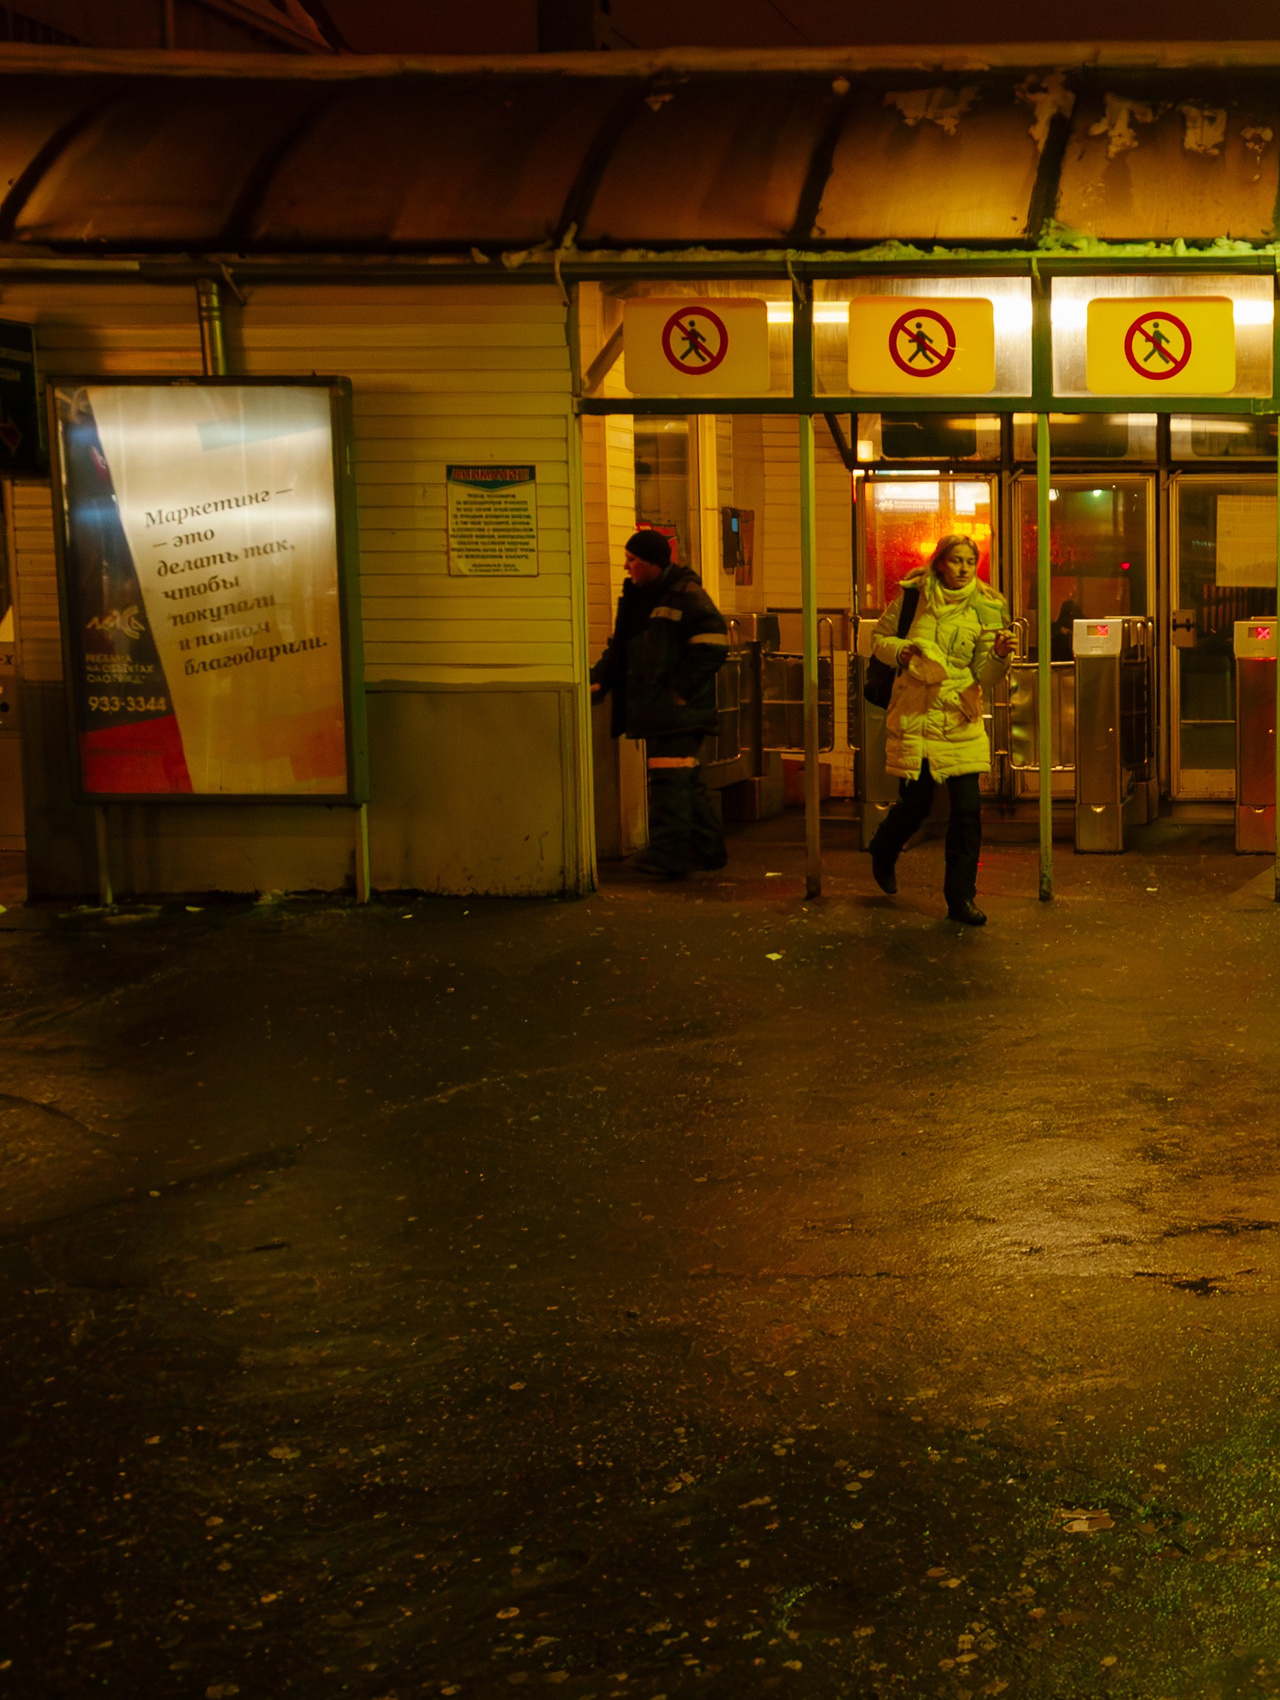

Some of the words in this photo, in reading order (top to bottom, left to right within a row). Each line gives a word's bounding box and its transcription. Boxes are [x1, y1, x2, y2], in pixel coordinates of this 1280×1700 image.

[144, 490, 270, 528] Маркетинг
[172, 528, 215, 548] это
[157, 550, 239, 577] делать
[243, 538, 296, 559] так,
[162, 574, 240, 601] чтобы
[169, 594, 275, 627] покупали
[196, 621, 271, 650] потом
[184, 636, 328, 676] благодарили.
[88, 696, 167, 712] 933-3344
